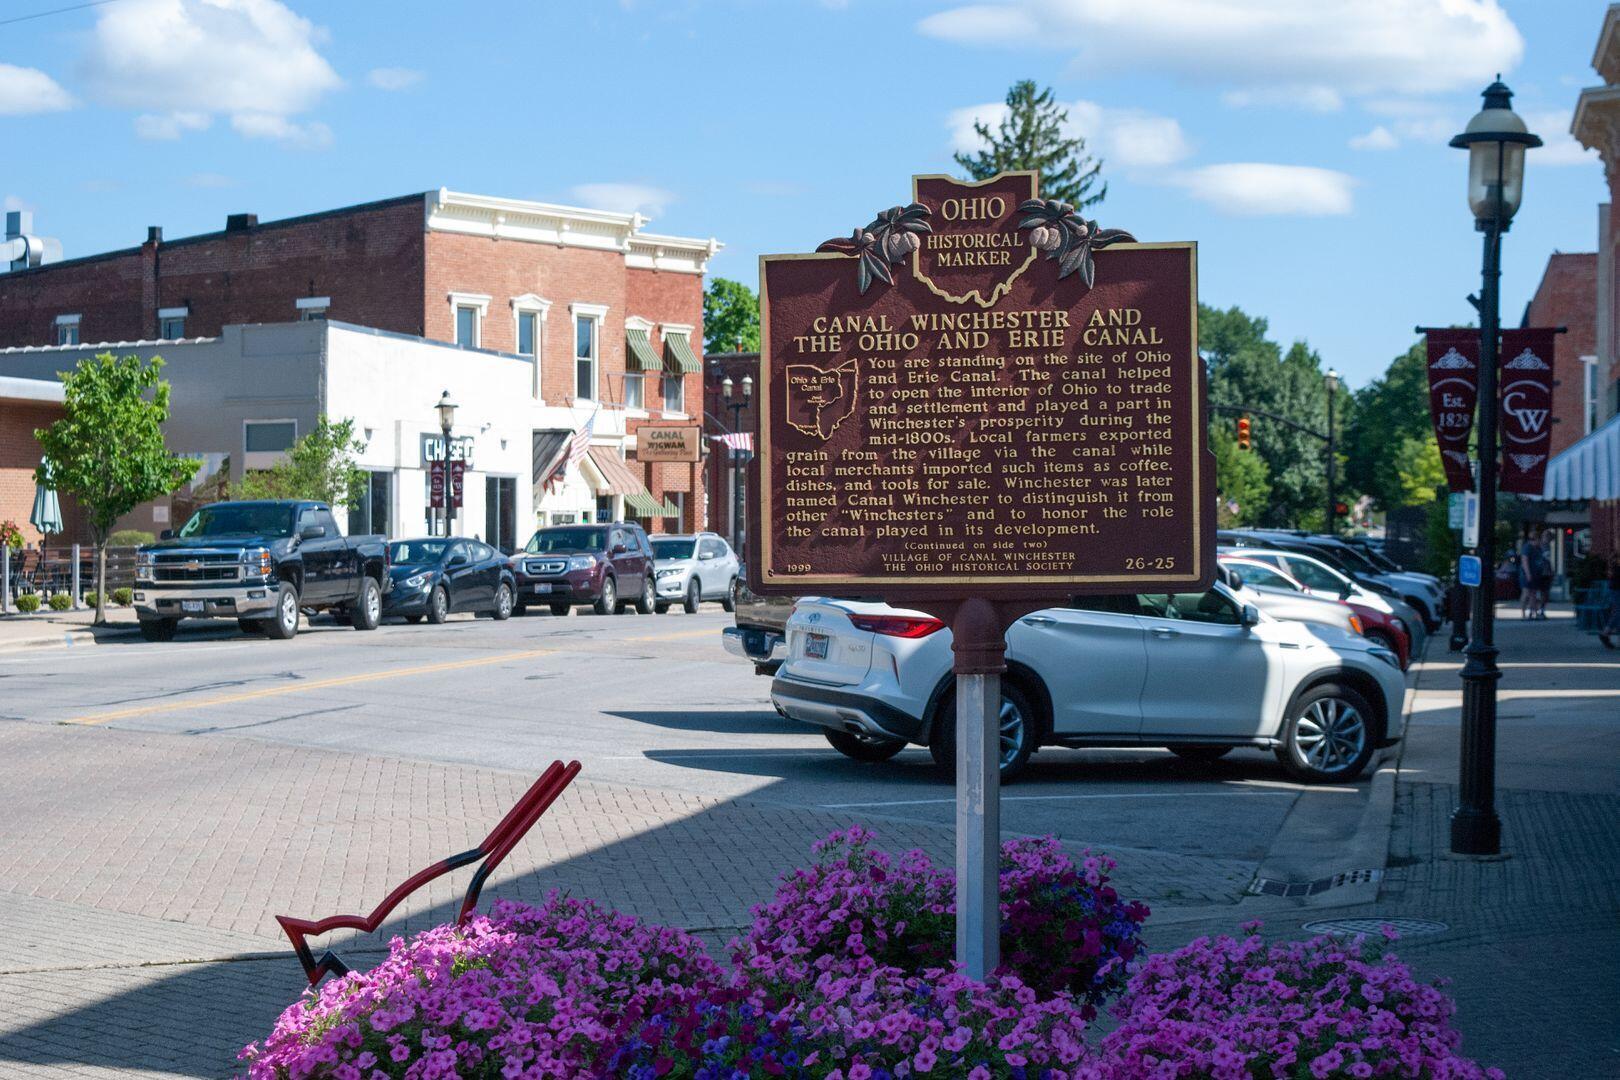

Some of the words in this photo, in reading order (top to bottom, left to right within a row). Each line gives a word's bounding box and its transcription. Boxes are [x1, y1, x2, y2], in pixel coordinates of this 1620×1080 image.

[941, 197, 1006, 220] OHIO
[927, 232, 1023, 250] HISTORICAL
[938, 251, 1011, 266] MARKER
[813, 315, 891, 333] CANAL
[911, 310, 1070, 331] WINCHESTER
[1090, 309, 1141, 326] AND
[793, 335, 841, 352] THE
[859, 333, 919, 351] OHIO
[937, 332, 989, 349] AND
[1009, 330, 1064, 347] ERIE
[1084, 327, 1163, 345] CANAL
[868, 357, 896, 368] You
[903, 358, 930, 368] are
[939, 355, 1005, 369] standing
[1016, 356, 1034, 365] on
[1044, 353, 1068, 364] the
[1078, 353, 1103, 363] site
[1112, 351, 1127, 363] of
[1136, 351, 1171, 362] Ohio
[869, 373, 897, 384] and
[908, 371, 939, 383] Erie
[951, 368, 1002, 382] Canal.
[1019, 369, 1050, 381] The
[1062, 368, 1104, 380] canal
[1118, 366, 1171, 380] helped
[869, 389, 884, 399] to
[892, 389, 929, 401] open
[938, 387, 961, 397] the
[971, 385, 1030, 397] interior
[1038, 384, 1053, 395] of
[1062, 384, 1097, 395] Ohio
[1107, 384, 1121, 394] to
[1129, 382, 1171, 393] trade
[869, 403, 897, 414] and
[907, 399, 989, 413] settlement
[998, 400, 1025, 411] and
[1036, 399, 1089, 414] played
[1099, 401, 1107, 409] a
[1117, 399, 1150, 412] part
[1157, 397, 1171, 409] in
[869, 416, 965, 429] Winchester's
[980, 415, 1064, 430] prosperity
[1080, 414, 1132, 428] during
[1146, 413, 1172, 425] the
[650, 431, 684, 440] CANAL
[869, 432, 955, 444] mid-1800s.
[969, 430, 1013, 443] Local
[1026, 431, 1086, 442] farmers
[1100, 428, 1172, 443] exported
[647, 441, 686, 449] WIGWAM
[787, 450, 828, 464] grain
[842, 449, 878, 460] from
[892, 448, 917, 460] the
[928, 447, 981, 462] village
[995, 446, 1017, 458] via
[1031, 446, 1056, 457] the
[1073, 445, 1116, 456] canal
[1131, 444, 1172, 455] while
[787, 464, 825, 476] local
[835, 464, 914, 475] merchants
[923, 461, 992, 477] imported
[1002, 462, 1035, 473] such
[1044, 462, 1083, 472] items
[1094, 463, 1109, 471] as
[845, 480, 872, 490] and
[882, 479, 919, 490] tools
[928, 477, 950, 489] for
[958, 478, 990, 489] sale.
[1005, 477, 1091, 488] Winchester
[1101, 478, 1127, 486] was
[1137, 476, 1173, 486] later
[787, 495, 837, 506] named
[848, 494, 893, 505] Canal
[903, 493, 989, 505] Winchester
[998, 494, 1012, 504] to
[1022, 492, 1108, 507] distinguish
[1118, 491, 1128, 502] it
[1138, 490, 1173, 502] from
[787, 510, 827, 521] other
[968, 509, 994, 520] and
[1011, 509, 1025, 519] to
[1042, 507, 1088, 519] honor
[1103, 507, 1127, 518] the
[1142, 506, 1173, 517] role
[787, 526, 811, 536] the
[822, 525, 865, 536] canal
[877, 525, 928, 538] played
[939, 525, 953, 535] in
[966, 524, 983, 535] its
[995, 523, 1099, 537] development.
[904, 541, 965, 550] (Continued
[1023, 540, 1048, 550] two)
[939, 553, 952, 561] OF
[960, 553, 996, 561] CANAL
[1004, 552, 1075, 560] WINCHESTER
[1126, 557, 1174, 569] 26-25
[788, 564, 811, 572] 1999
[952, 563, 1019, 571] HISTORICAL
[1026, 562, 1072, 570] SOCIETY
